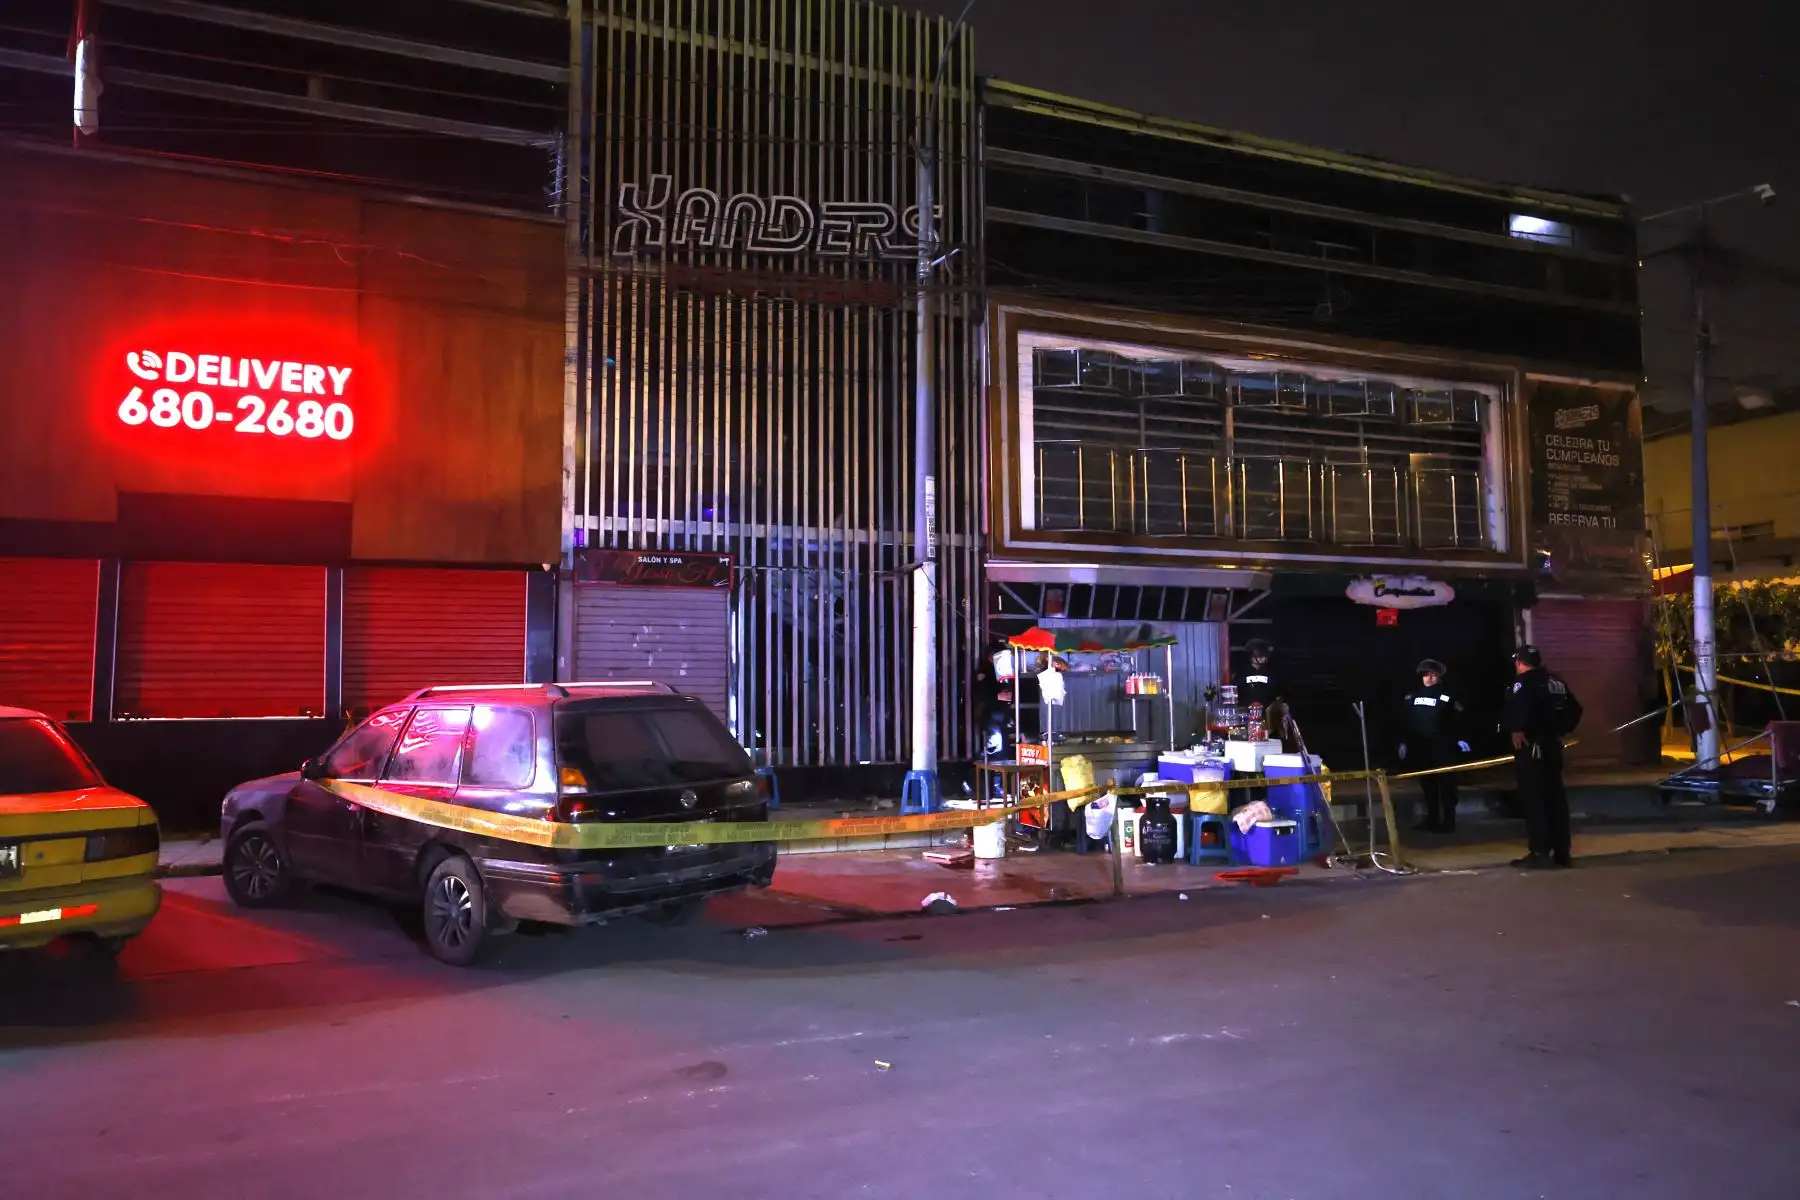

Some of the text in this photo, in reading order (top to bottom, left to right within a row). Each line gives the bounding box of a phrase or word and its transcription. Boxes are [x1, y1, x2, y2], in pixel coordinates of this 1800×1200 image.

[613, 174, 943, 258] XANDERS
[166, 351, 352, 396] DELIVERY
[117, 386, 354, 440] 680-2680
[1545, 434, 1610, 451] CELEBRA TU
[1549, 513, 1599, 528] RESERVA
[638, 555, 662, 564] SALÓN
